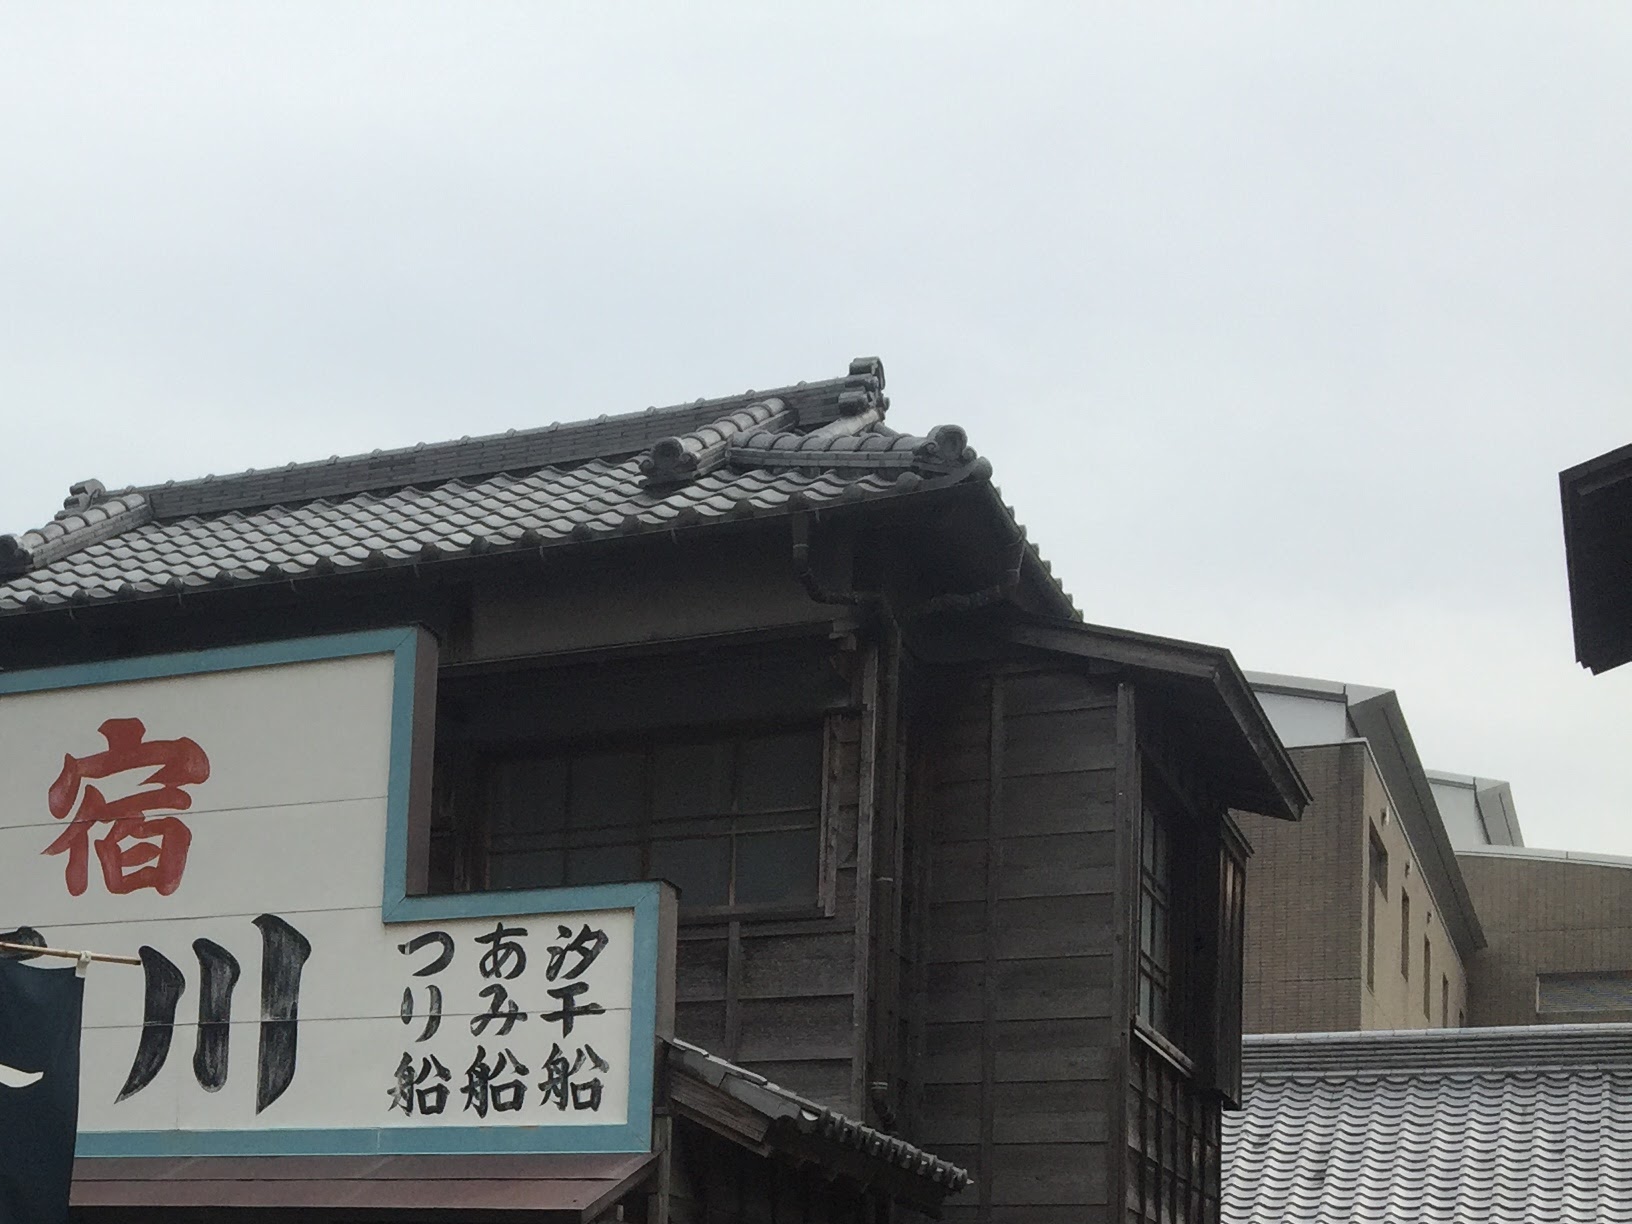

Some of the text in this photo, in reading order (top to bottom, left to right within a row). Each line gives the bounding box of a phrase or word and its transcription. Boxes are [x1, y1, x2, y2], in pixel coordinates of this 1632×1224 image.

[387, 931, 455, 1117] つり船
[460, 922, 530, 1118] あみ船
[538, 923, 610, 1112] 汐干船
